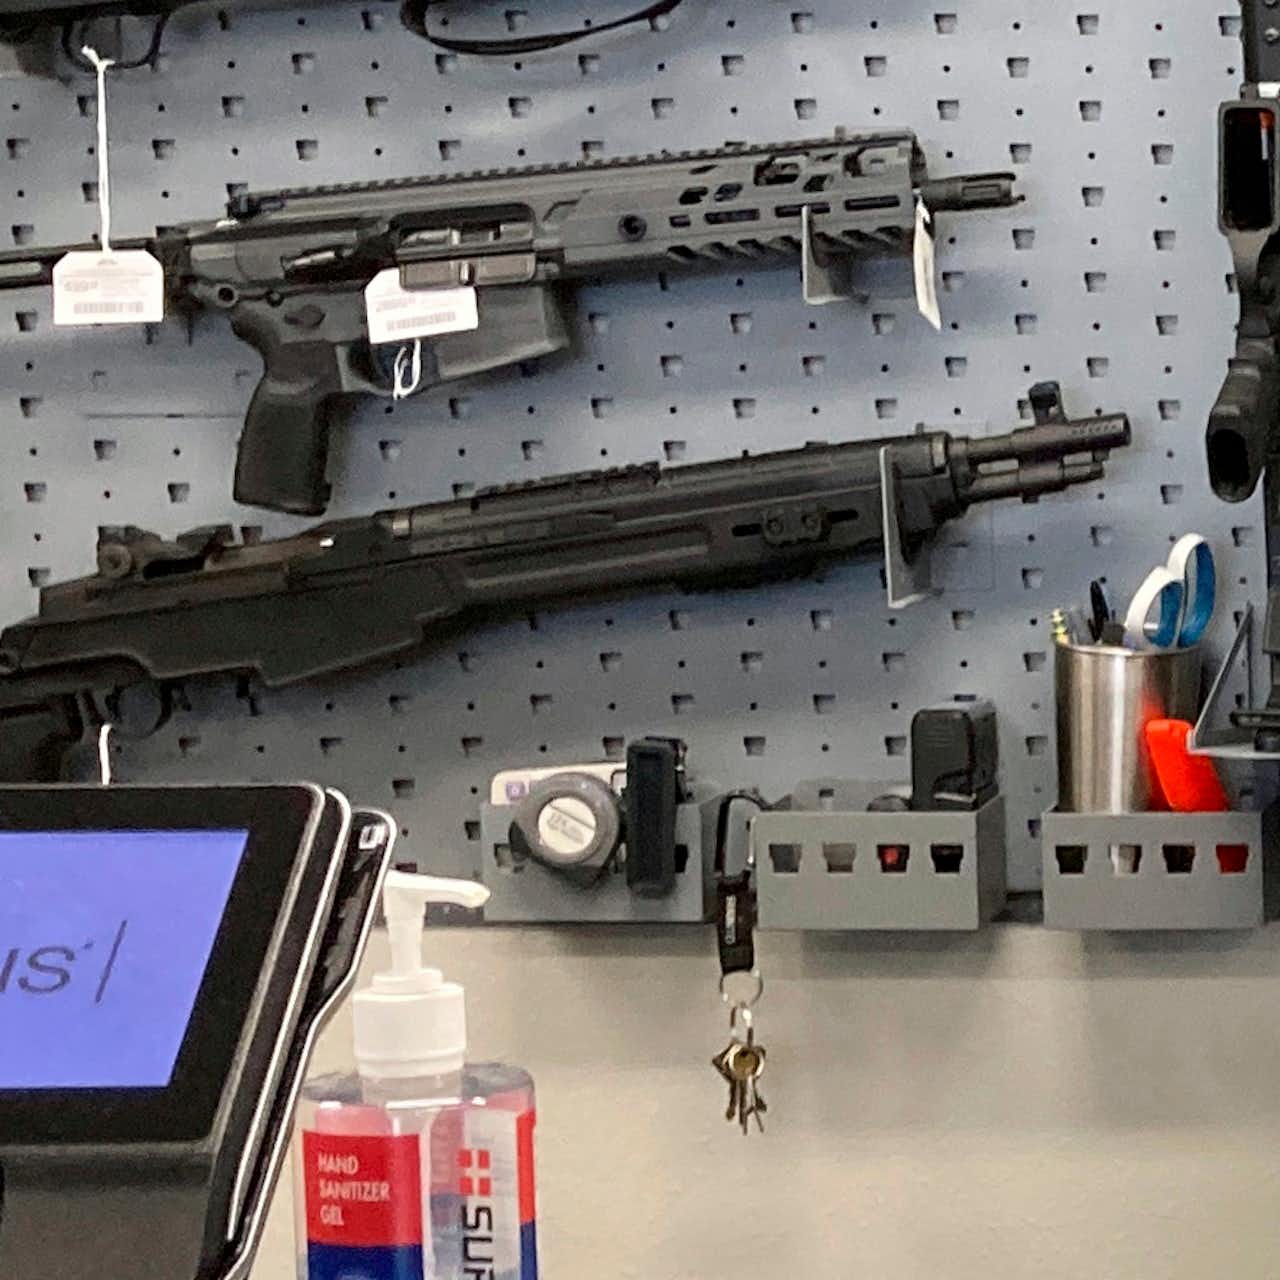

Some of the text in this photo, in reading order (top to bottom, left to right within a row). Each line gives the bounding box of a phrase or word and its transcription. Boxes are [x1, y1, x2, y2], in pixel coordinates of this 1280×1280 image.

[318, 1153, 359, 1175] HAND
[319, 1177, 391, 1202] SANITIZER
[320, 1205, 345, 1226] GEL
